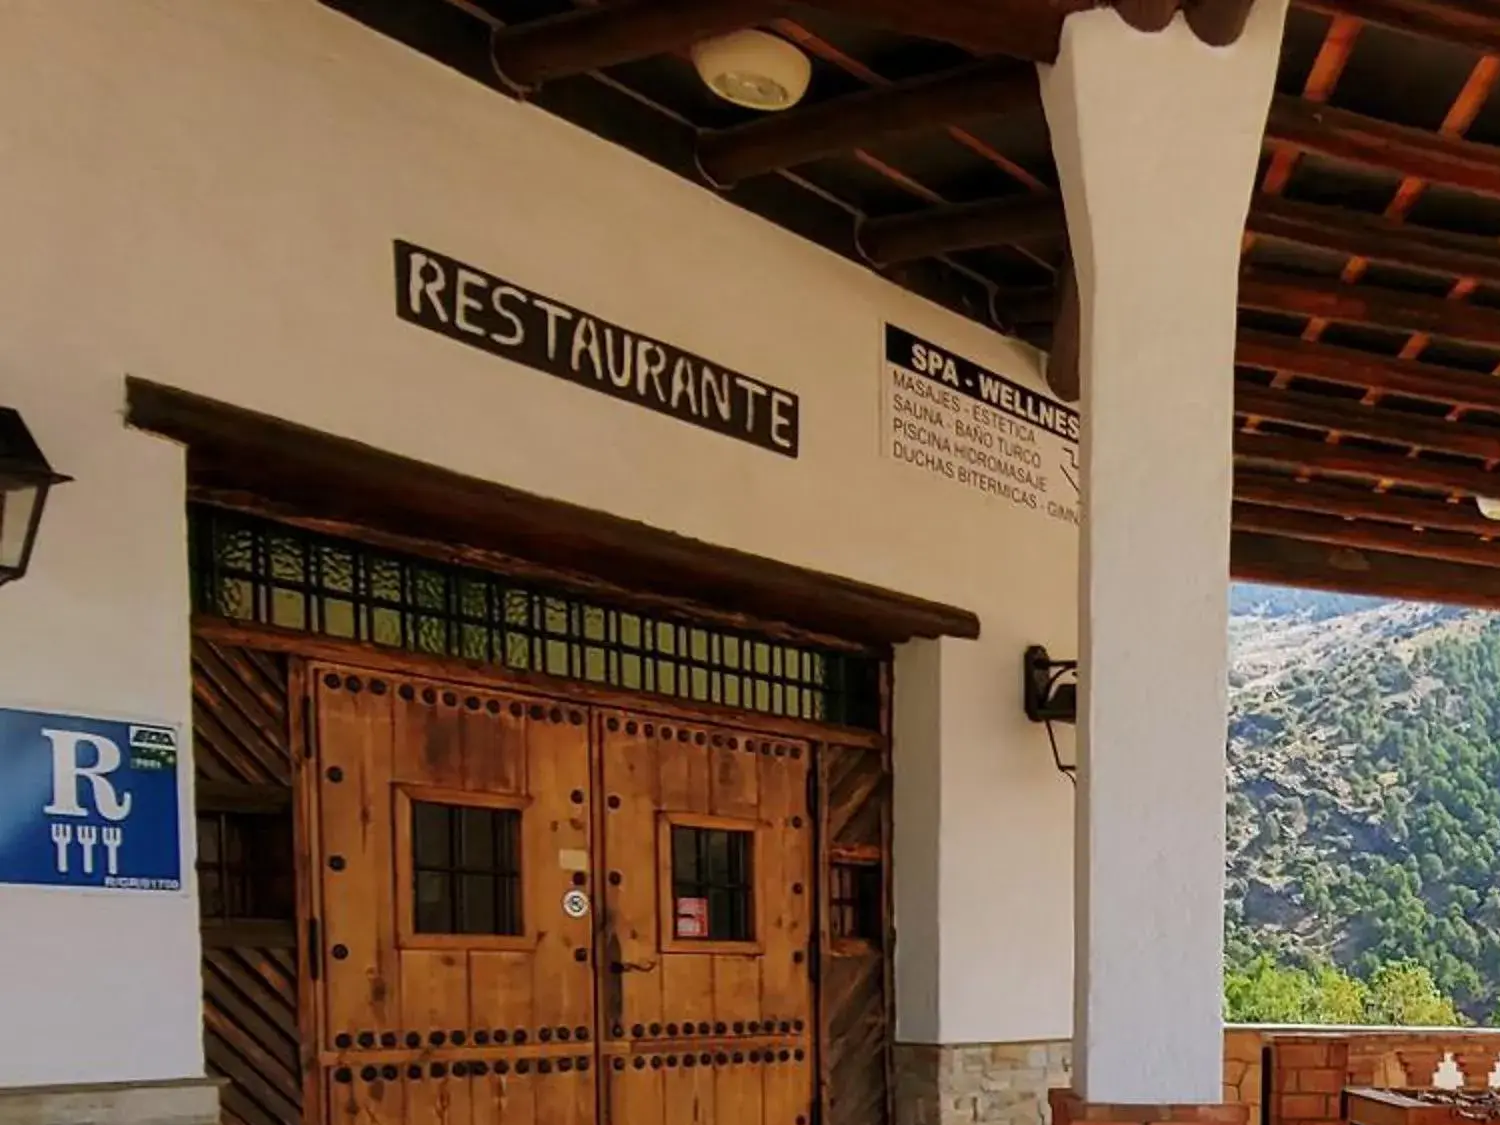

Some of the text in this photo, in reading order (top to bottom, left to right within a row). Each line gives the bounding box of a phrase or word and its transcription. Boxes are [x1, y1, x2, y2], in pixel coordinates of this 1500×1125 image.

[408, 251, 794, 449] RESTAURANTE
[892, 369, 1036, 443] MASAJES ESTETICA
[911, 342, 1080, 438] SPA WELLNES
[892, 394, 1041, 469] SAUNA BAÑO TURCO
[892, 418, 950, 453] PISCINA
[892, 441, 955, 480] DUCHAS
[957, 466, 1037, 510] BITERMICAS
[41, 728, 132, 821] R
